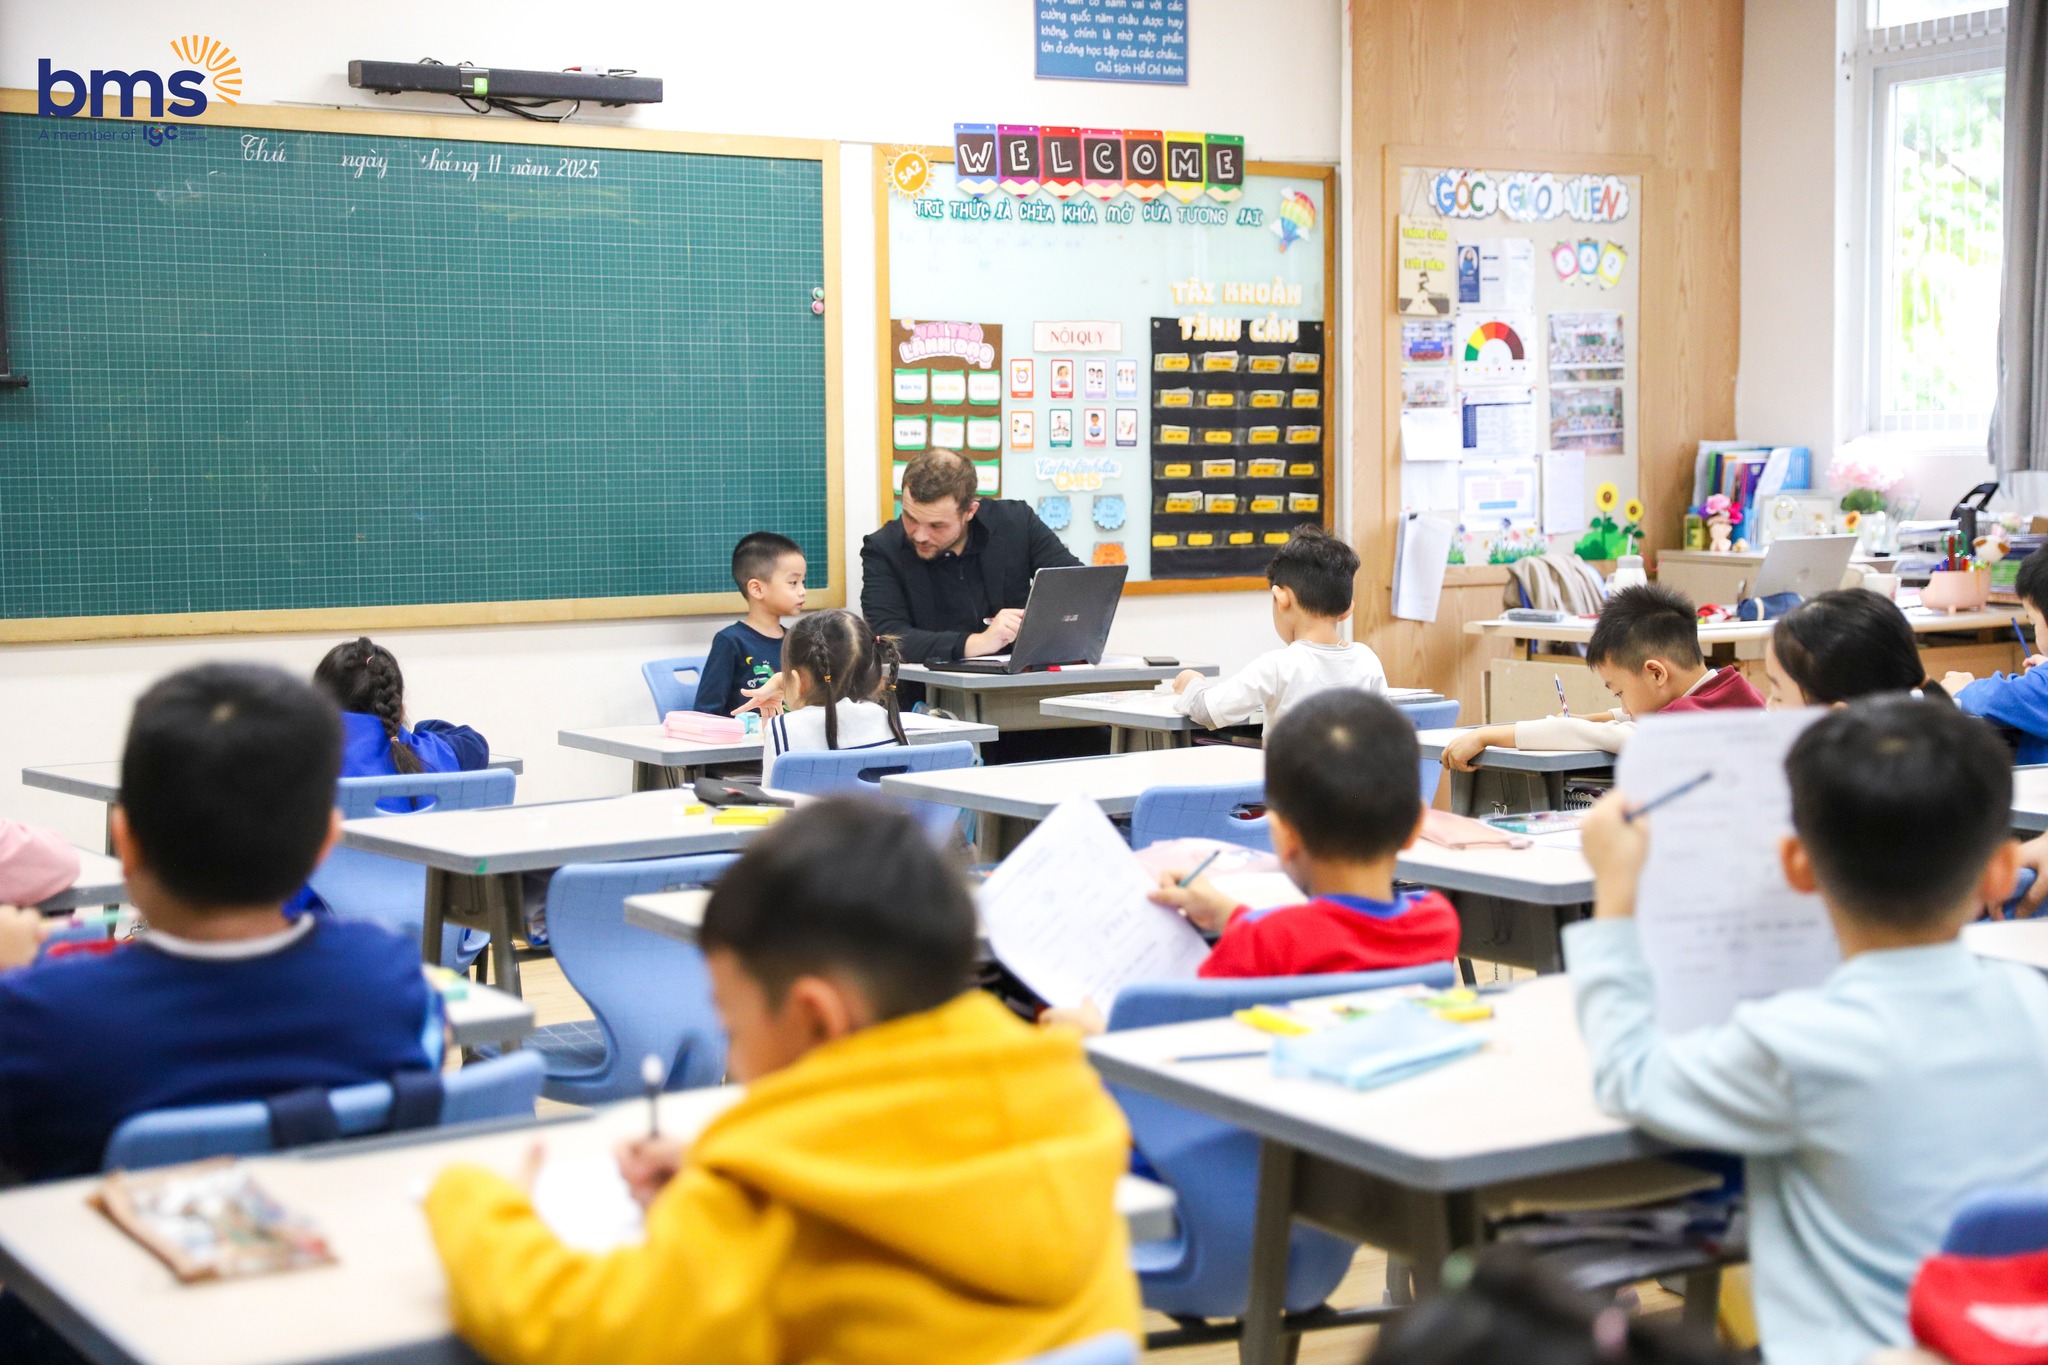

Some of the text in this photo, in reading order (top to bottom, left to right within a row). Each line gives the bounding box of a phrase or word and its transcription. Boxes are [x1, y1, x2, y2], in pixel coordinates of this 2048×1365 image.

[1041, 8, 1184, 30] cường quốc năm châu được hay
[1074, 27, 1097, 39] chính
[1103, 28, 1111, 40] là
[1117, 29, 1134, 41] nhờ
[1138, 31, 1157, 44] một
[1064, 43, 1084, 57] công
[1086, 45, 1102, 57] học
[1103, 45, 1120, 60] tập
[1121, 45, 1137, 58] của
[1095, 60, 1184, 76] Chủ tịch Hồ Chí Minh
[342, 149, 389, 178] ngày
[509, 157, 551, 177] năm
[556, 159, 600, 179] 2025
[897, 159, 925, 185] 5A2
[960, 140, 1235, 180] WELCOME
[1436, 172, 1486, 214] GÓC
[915, 200, 943, 217] TRI
[950, 199, 990, 220] THỨC
[1019, 201, 1055, 223] CHÌA
[1062, 201, 1098, 223] KHÓA
[1144, 202, 1171, 223] CỬA
[1222, 276, 1302, 306] KHOẢN
[1050, 327, 1104, 346] NỘI QUY
[1249, 312, 1299, 343] CẢM
